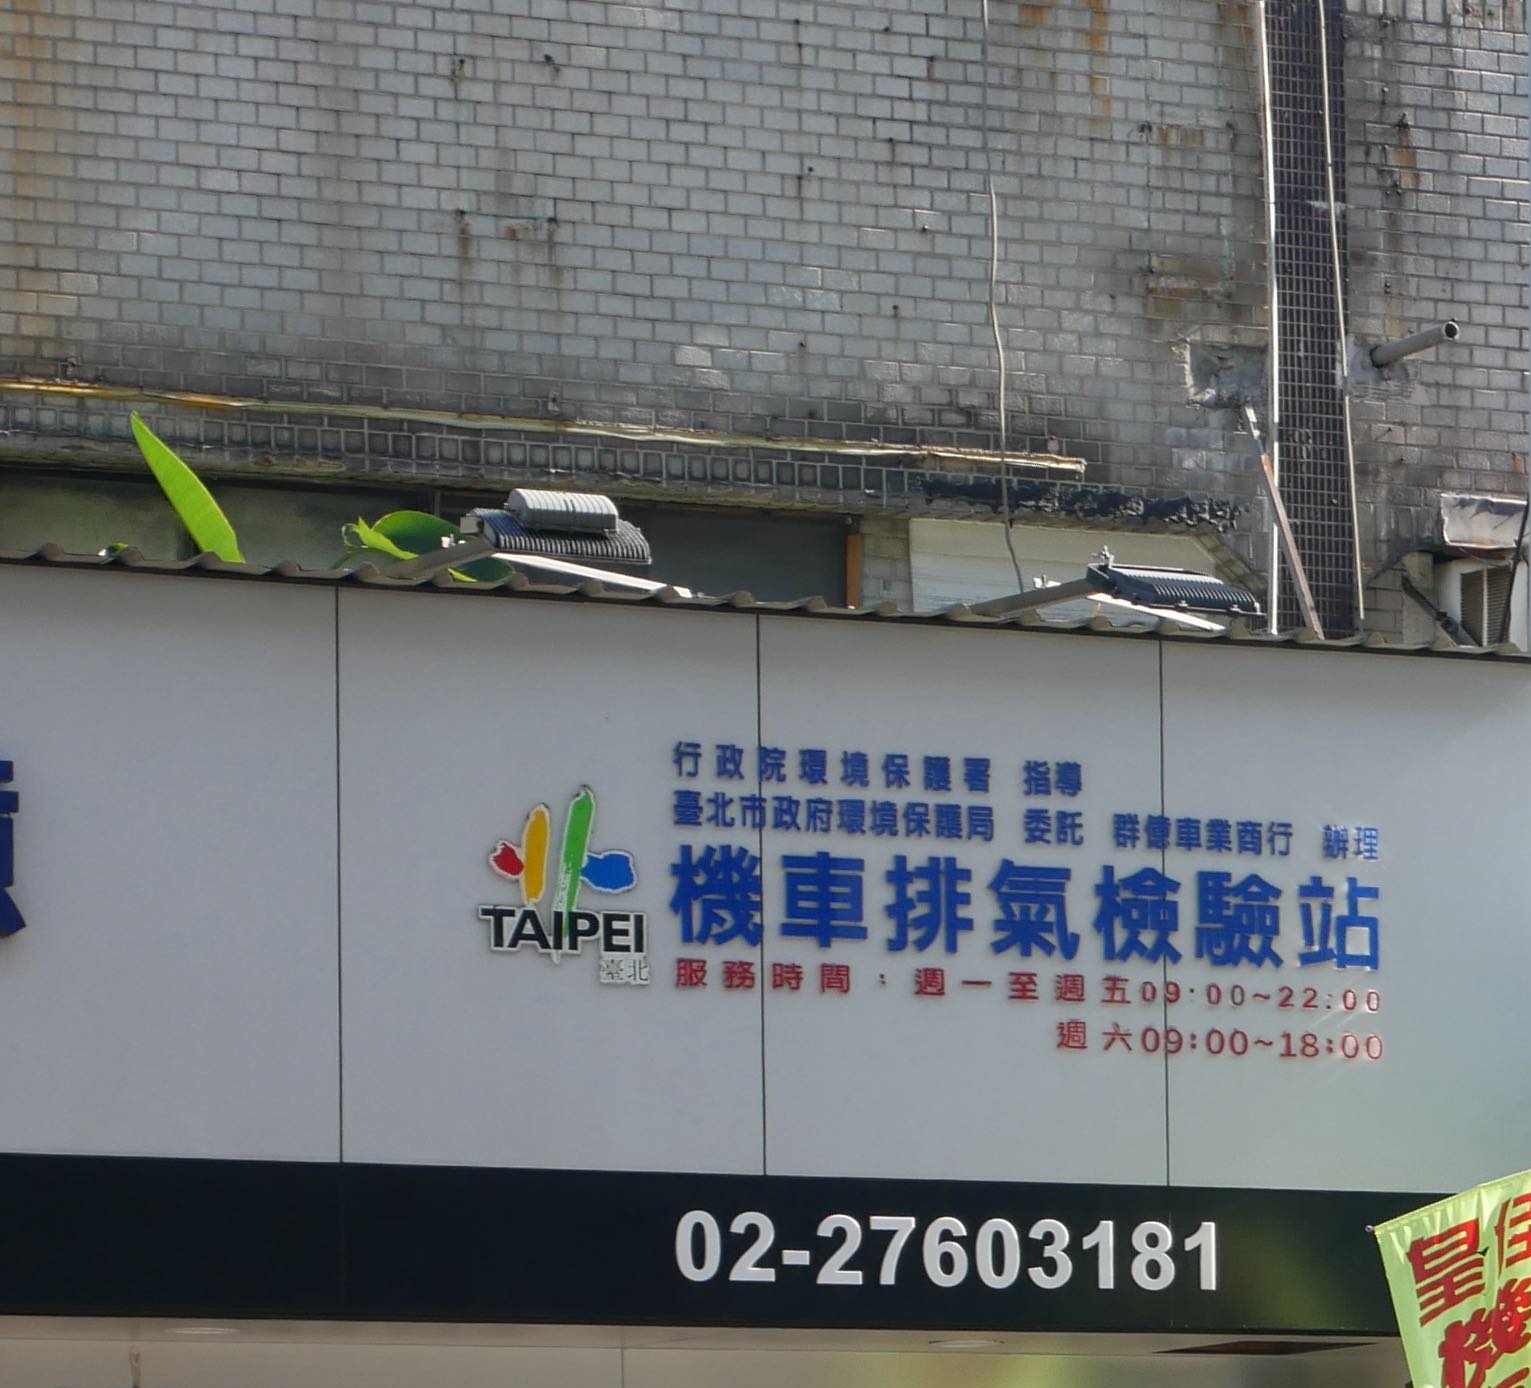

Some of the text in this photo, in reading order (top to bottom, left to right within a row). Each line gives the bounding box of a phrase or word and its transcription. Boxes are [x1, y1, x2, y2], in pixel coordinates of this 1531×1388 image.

[673, 741, 1082, 797] 行政院環境保護署 指導
[673, 790, 994, 842] 臺北市政府環境保護局
[1023, 808, 1084, 845] 委託
[480, 907, 644, 952] TAIPEI
[670, 843, 1380, 971] 機車排氣檢驗站
[675, 1210, 1217, 1291] 02-27603181
